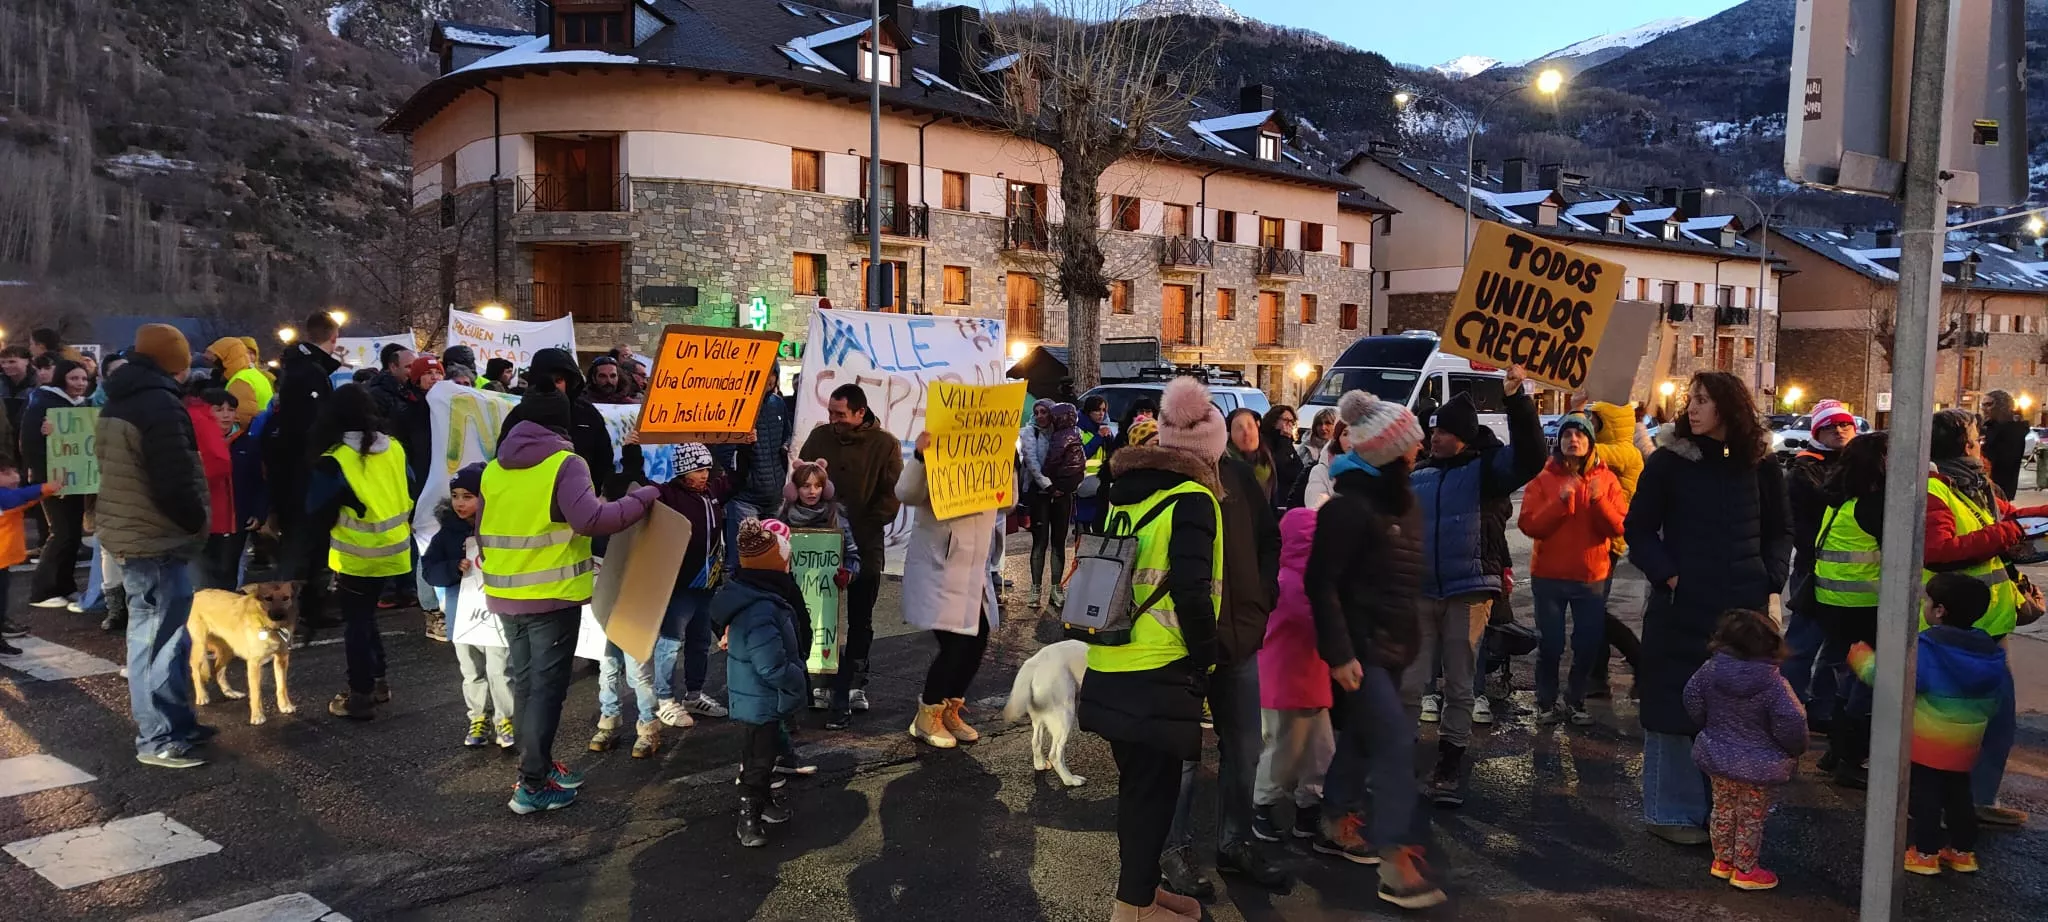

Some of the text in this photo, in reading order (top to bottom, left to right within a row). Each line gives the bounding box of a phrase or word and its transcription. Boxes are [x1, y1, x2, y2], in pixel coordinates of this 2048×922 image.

[1505, 233, 1603, 293] TODOS
[1475, 270, 1593, 343] UNIDOS
[502, 332, 521, 347] HA
[676, 340, 698, 359] Un
[704, 338, 740, 360] Valle
[820, 311, 949, 371] VALLE
[1454, 310, 1593, 389] CRECEMOS
[656, 369, 678, 389] Una
[682, 367, 745, 391] Comunidad
[939, 385, 990, 409] VALLE
[57, 411, 83, 434] Un
[650, 403, 668, 424] Un
[672, 402, 726, 424] Instituto
[953, 409, 1019, 430] SEPARADO
[51, 437, 84, 457] Una
[936, 433, 1002, 460] FUTURO
[931, 459, 1010, 502] AMENAZADO
[791, 550, 840, 569] NSTITUTO
[815, 626, 837, 646] EN
